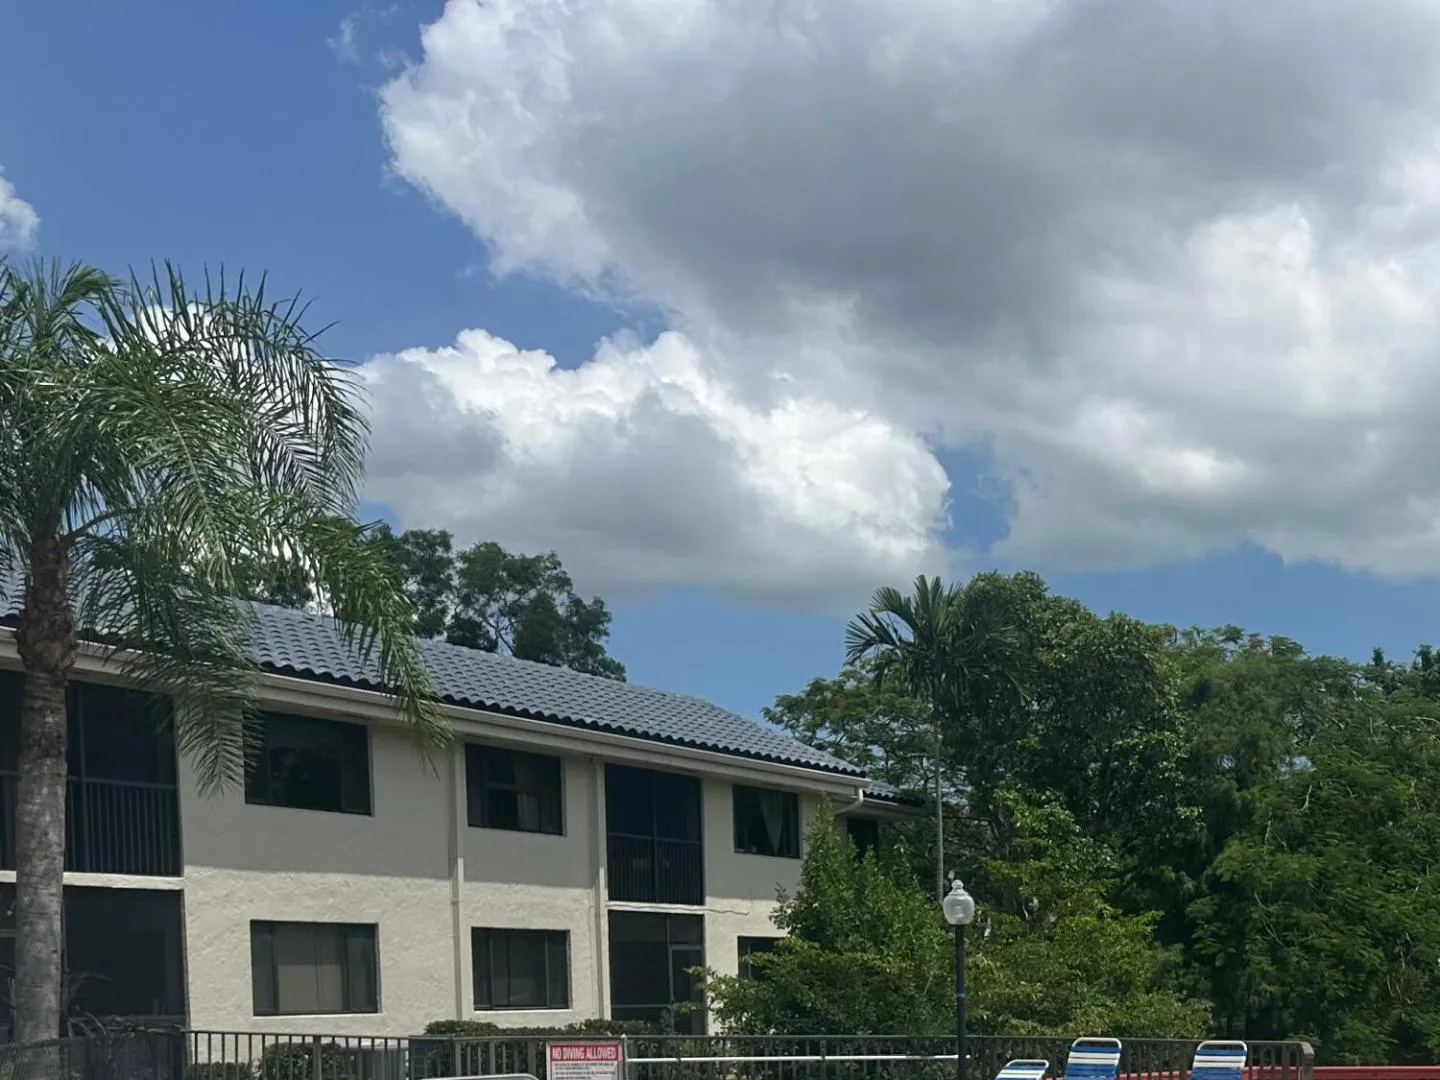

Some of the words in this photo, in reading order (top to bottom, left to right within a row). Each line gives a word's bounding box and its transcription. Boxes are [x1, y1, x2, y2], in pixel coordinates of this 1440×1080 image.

[552, 1047, 561, 1059] NO
[563, 1047, 585, 1059] DIVING
[586, 1047, 616, 1059] ALLOWED
